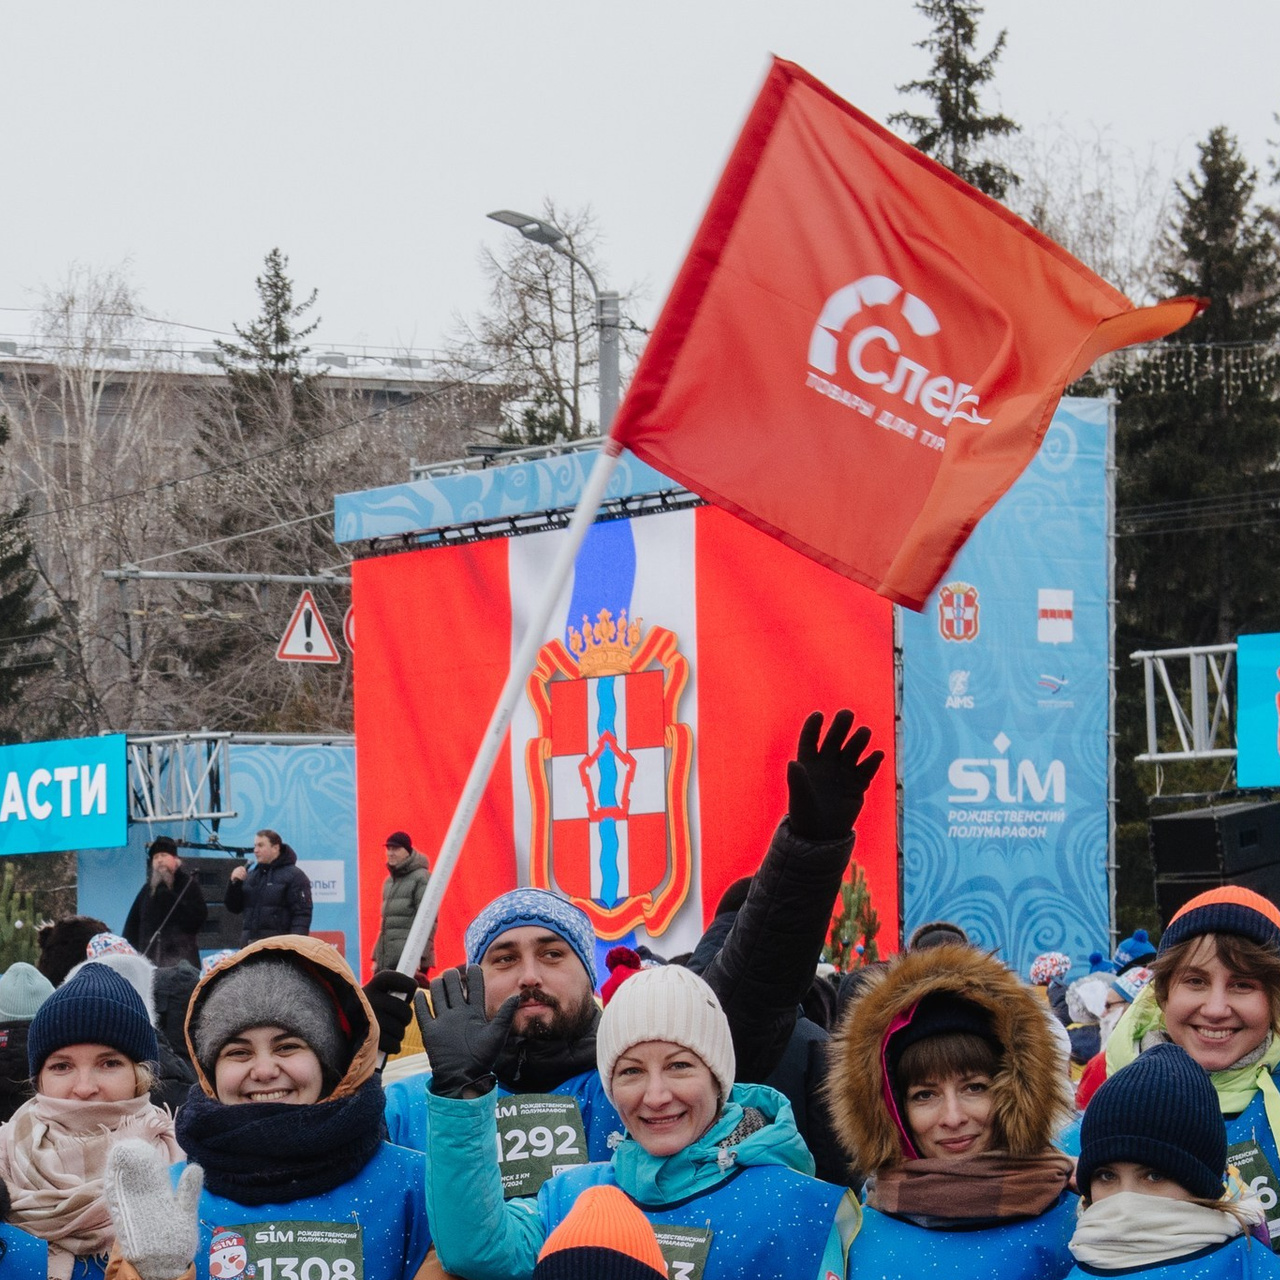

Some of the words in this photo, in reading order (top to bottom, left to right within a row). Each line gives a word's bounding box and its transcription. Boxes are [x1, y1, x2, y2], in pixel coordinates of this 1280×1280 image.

[948, 808, 1066, 823] РОЖДЕСТВЕНСКИЙ
[948, 825, 1047, 839] ПОЛУМАРАФОН
[519, 1102, 575, 1110] РОЖДЕСТВЕНСКИЙ
[297, 1230, 357, 1239] РОЖДЕСТВЕНСКИЙ
[297, 1236, 347, 1244] ПОЛУМАРАФОН
